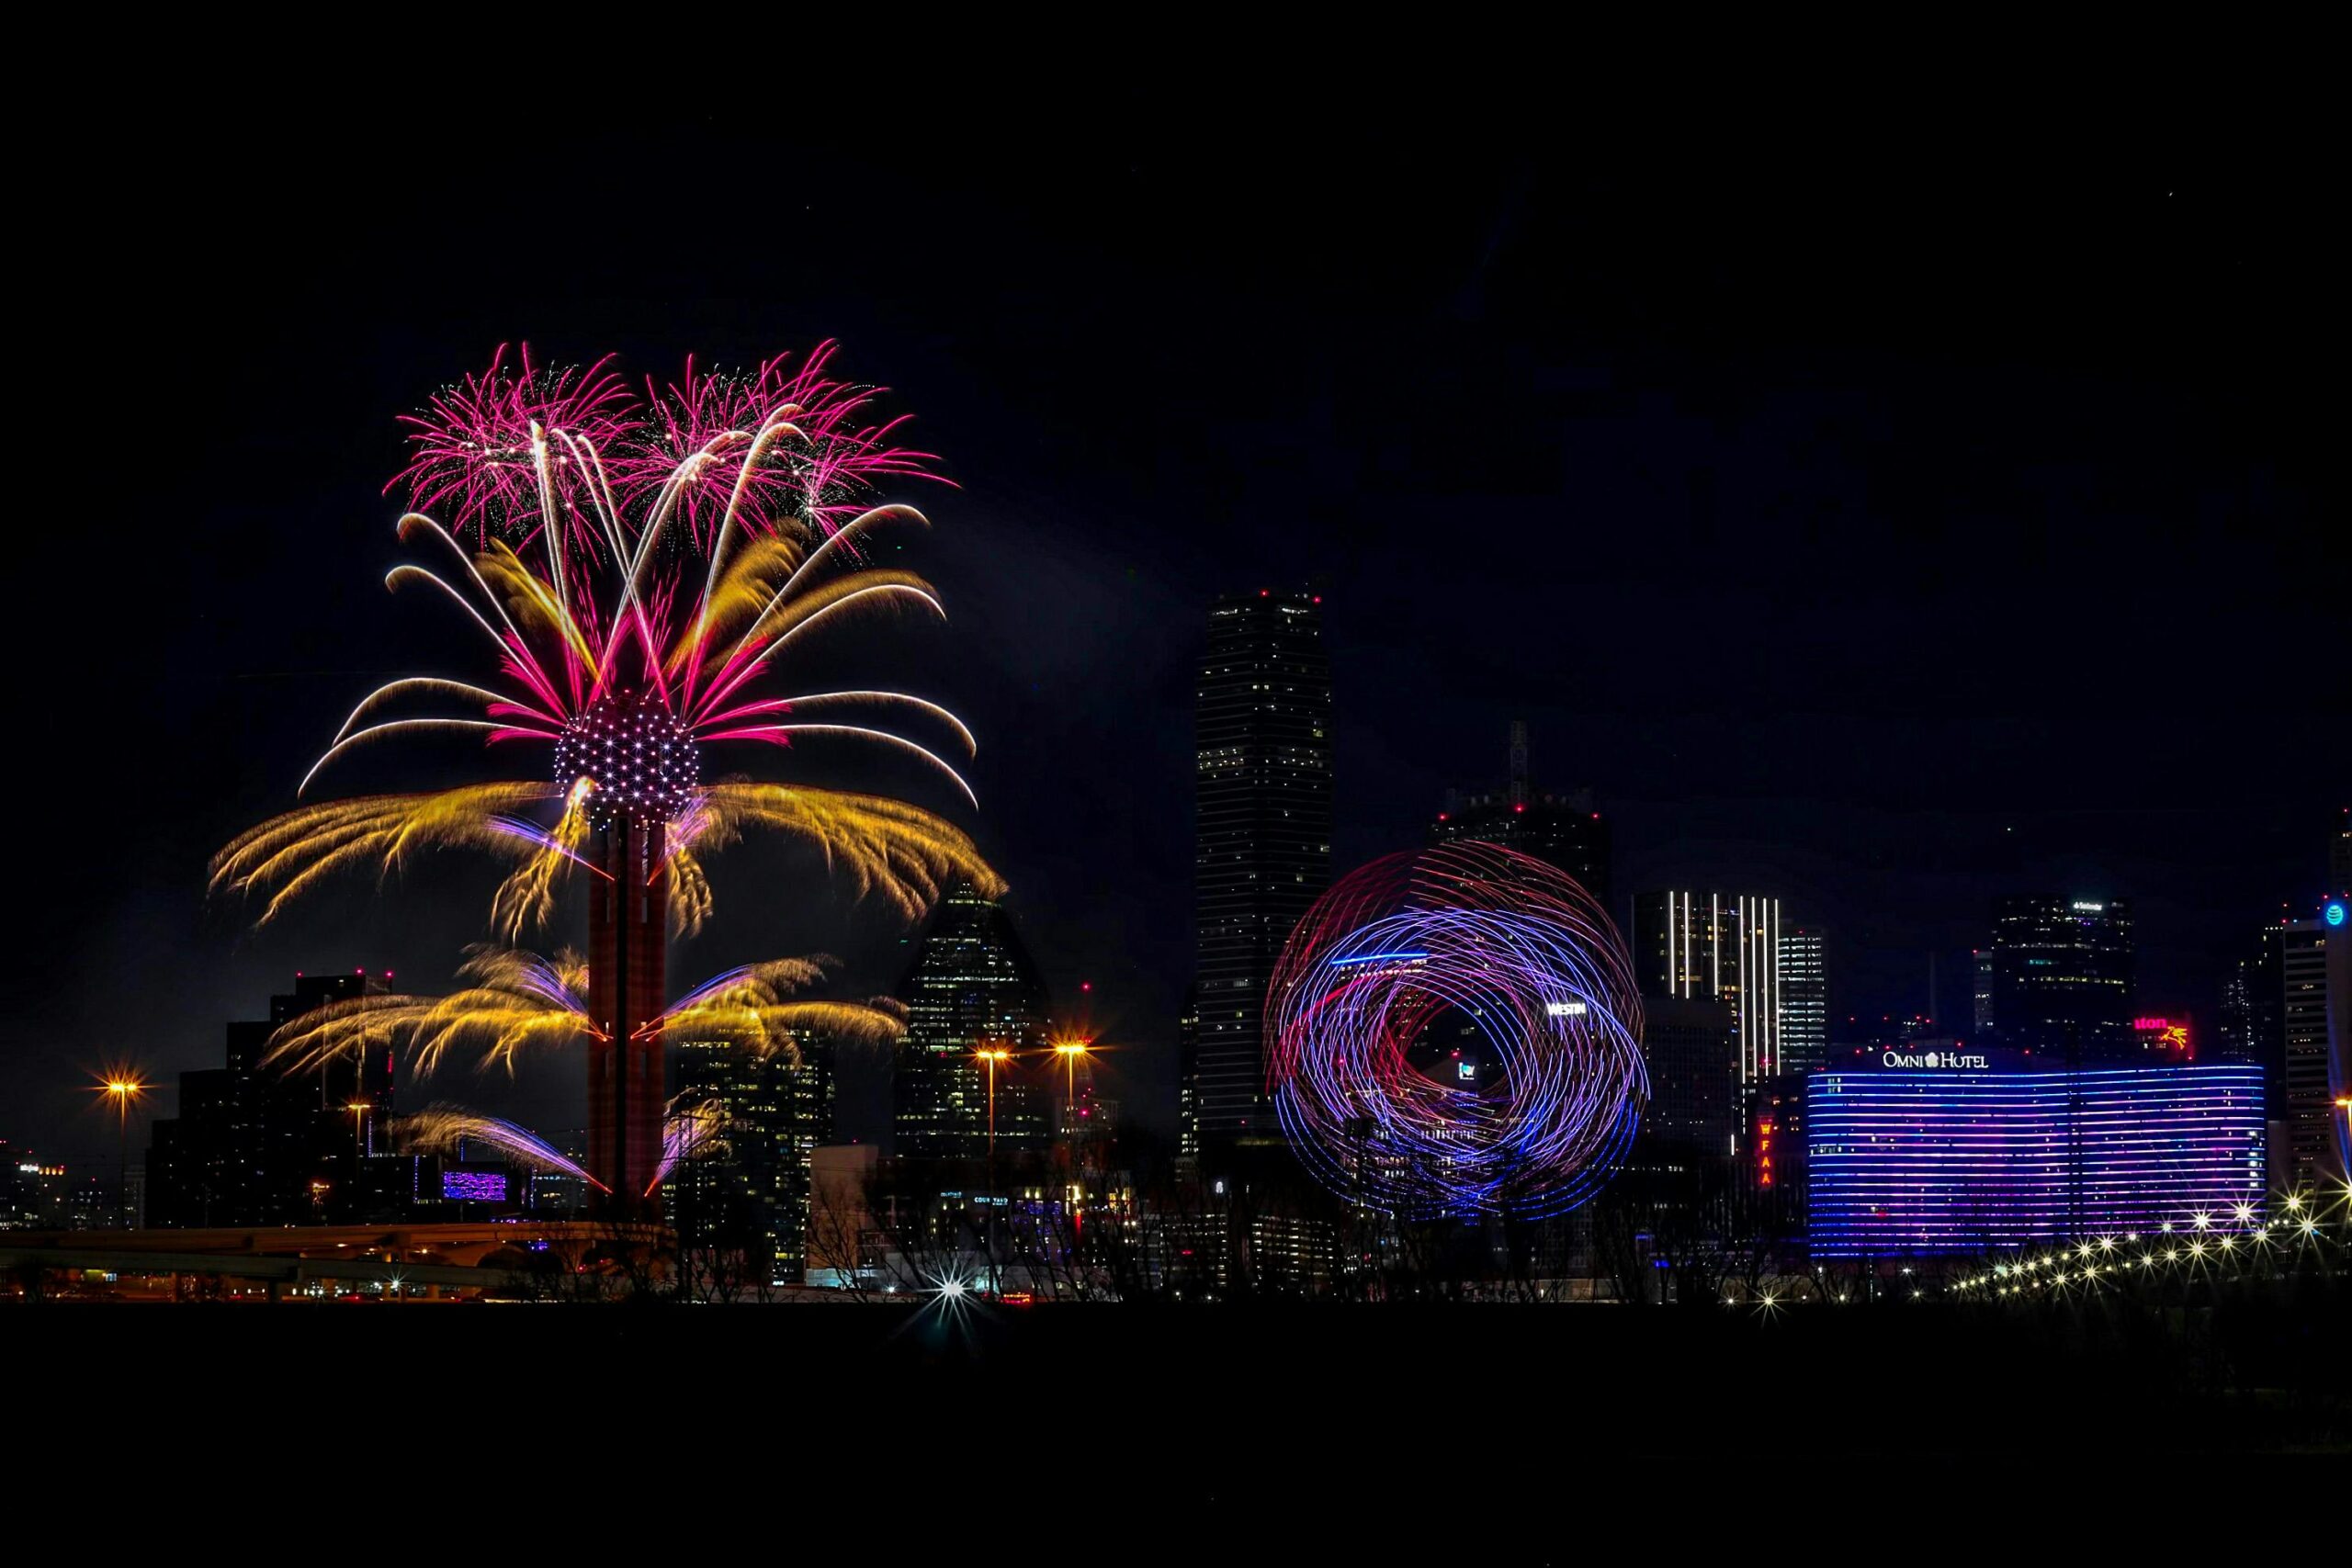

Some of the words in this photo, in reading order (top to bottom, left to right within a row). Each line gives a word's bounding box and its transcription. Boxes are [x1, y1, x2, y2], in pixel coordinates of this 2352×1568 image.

[1546, 1002, 1586, 1016] WESTIN
[1883, 1051, 1924, 1068] OMNI
[1940, 1052, 1989, 1068] HOTEL
[1760, 1123, 1771, 1184] WFAA
